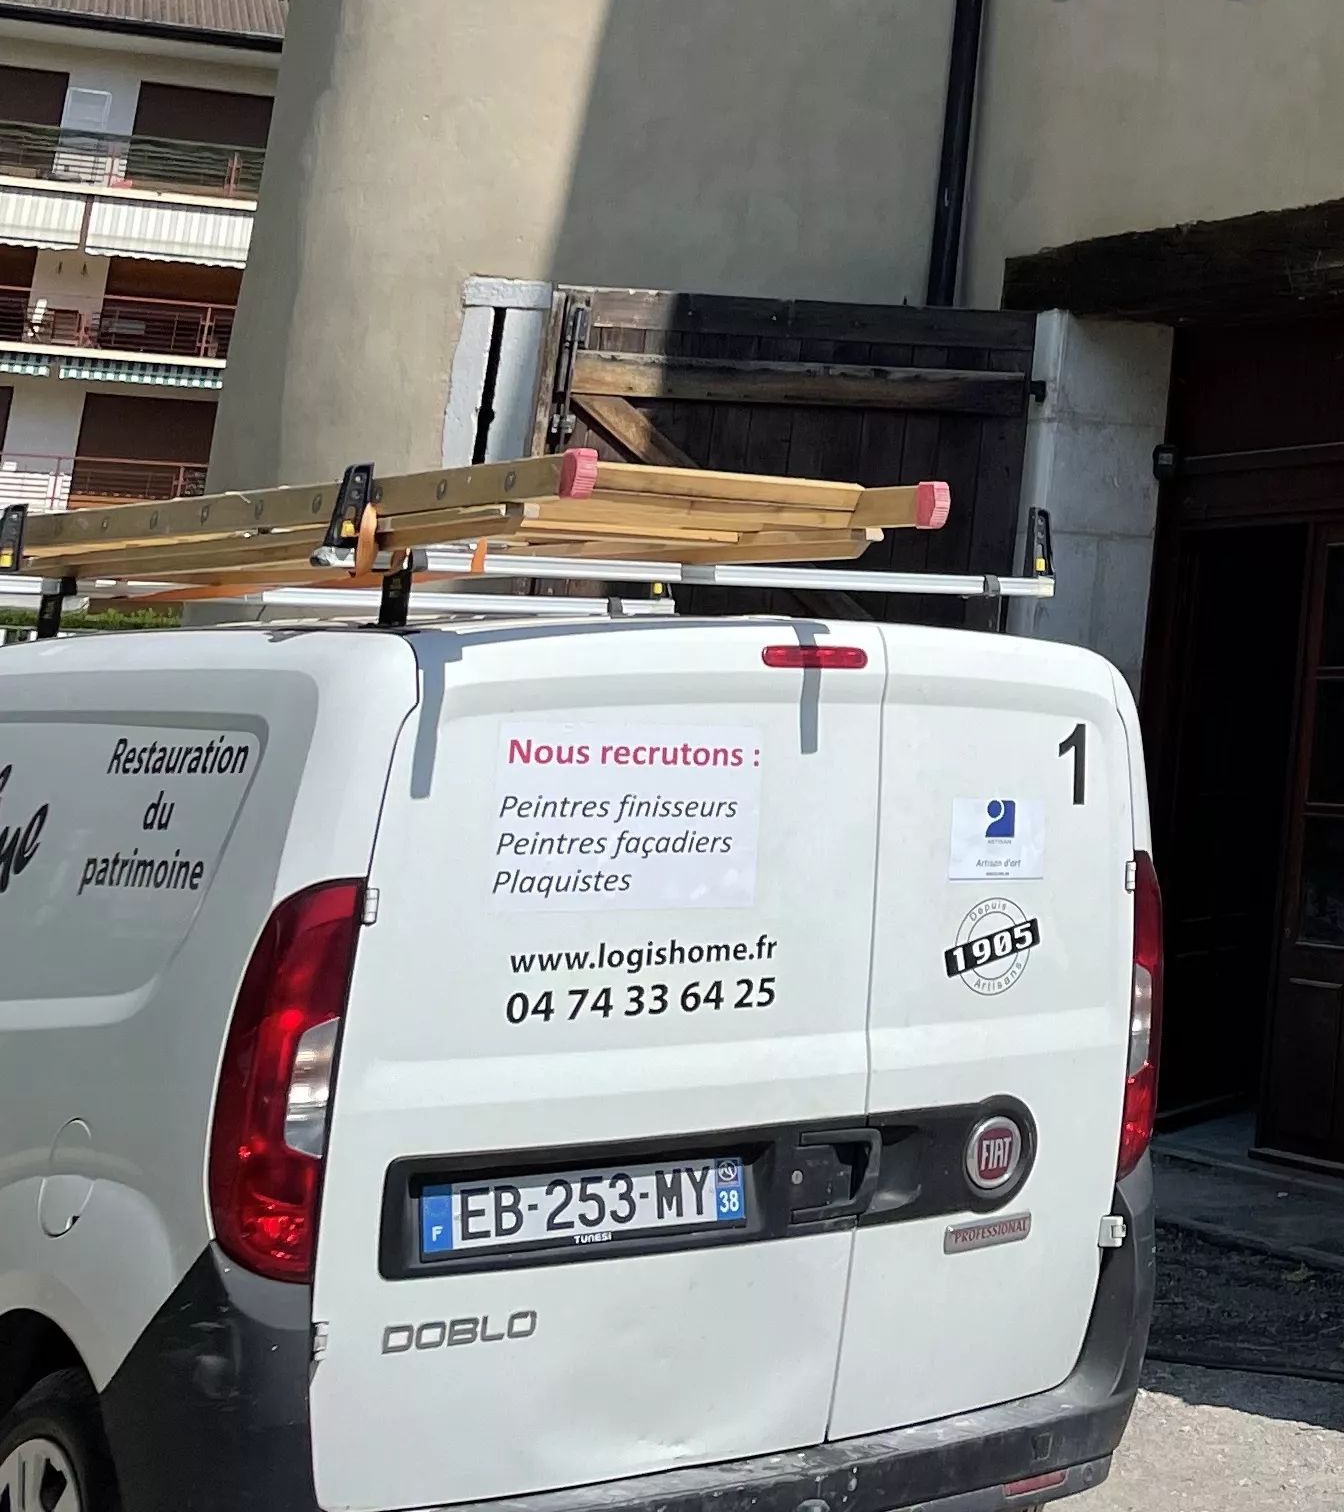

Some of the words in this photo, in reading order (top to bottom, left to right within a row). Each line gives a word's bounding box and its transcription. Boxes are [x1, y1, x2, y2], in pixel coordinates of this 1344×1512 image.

[106, 735, 250, 775] Restauration
[508, 739, 590, 765] Nous
[600, 743, 744, 767] recrutons
[1058, 722, 1087, 806] 1
[142, 790, 175, 830] du
[499, 795, 611, 818] Peintres
[613, 794, 738, 823] finisseurs
[496, 832, 607, 855] Peintres
[610, 830, 733, 859] façadiers
[76, 848, 205, 896] patrimoine
[492, 869, 632, 899] Plaquistes
[969, 901, 1007, 922] Depuis
[510, 934, 778, 974] www.logishome.fr
[974, 962, 1022, 992] Artisans
[506, 991, 555, 1024] 04
[567, 988, 614, 1020] 74
[624, 984, 669, 1017] 33
[680, 980, 725, 1012] 64
[733, 977, 776, 1008] 25
[980, 1137, 1012, 1171] FIAT
[431, 1226, 444, 1242] F
[460, 1166, 710, 1241] EB-253-MY
[719, 1190, 739, 1214] 38
[954, 1219, 1027, 1244] PROFESSIONAL
[381, 1310, 538, 1355] DOBLO
